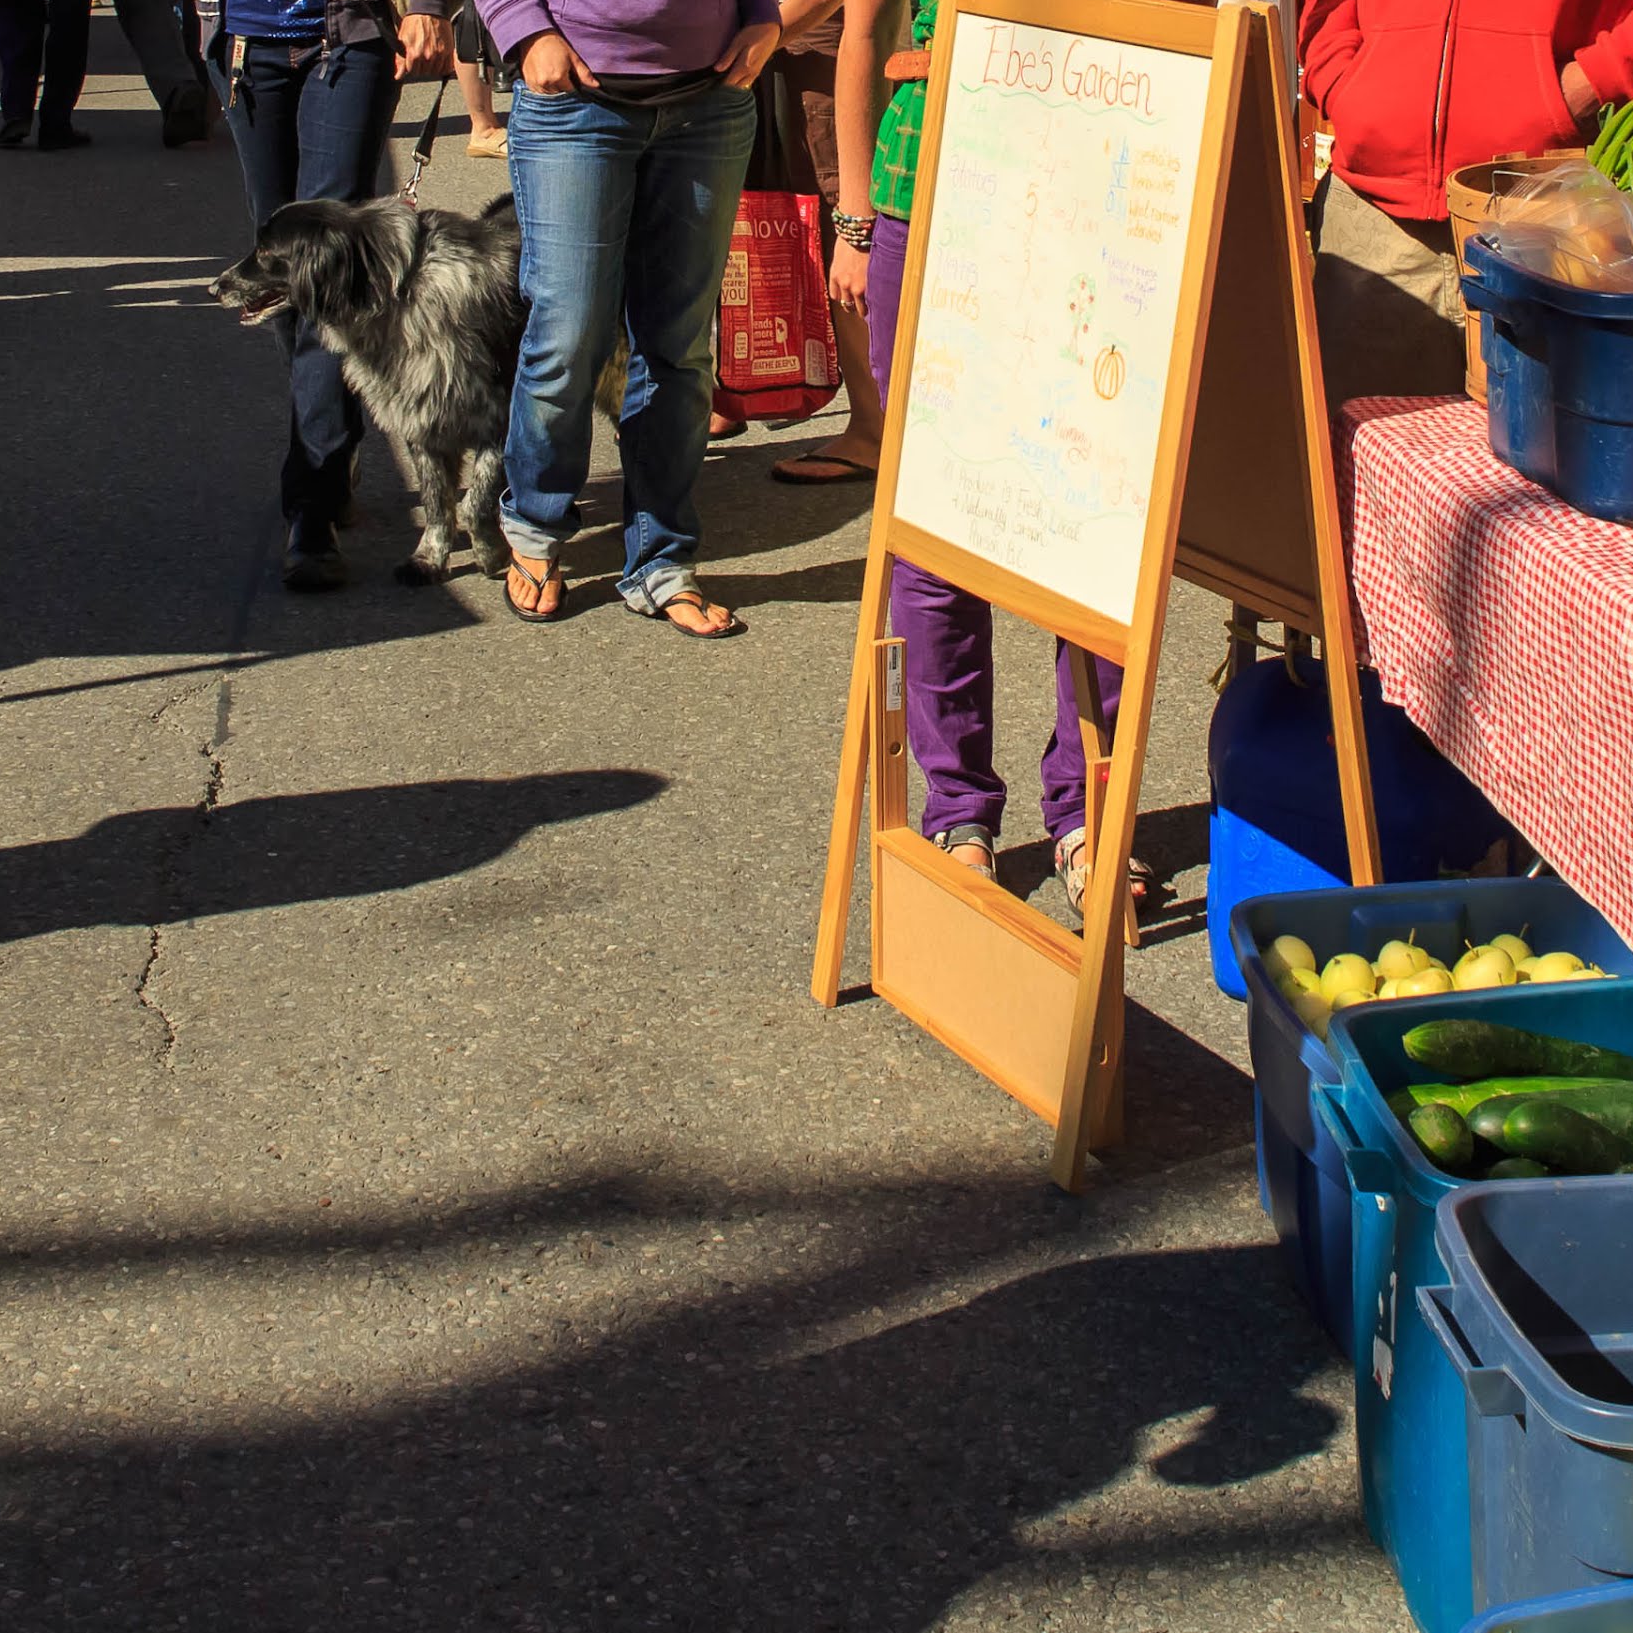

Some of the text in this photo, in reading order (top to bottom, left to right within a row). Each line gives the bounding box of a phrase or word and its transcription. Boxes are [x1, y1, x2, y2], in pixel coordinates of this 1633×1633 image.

[983, 25, 1153, 116] Ebe's Garden
[753, 218, 799, 239] love
[721, 288, 746, 304] you
